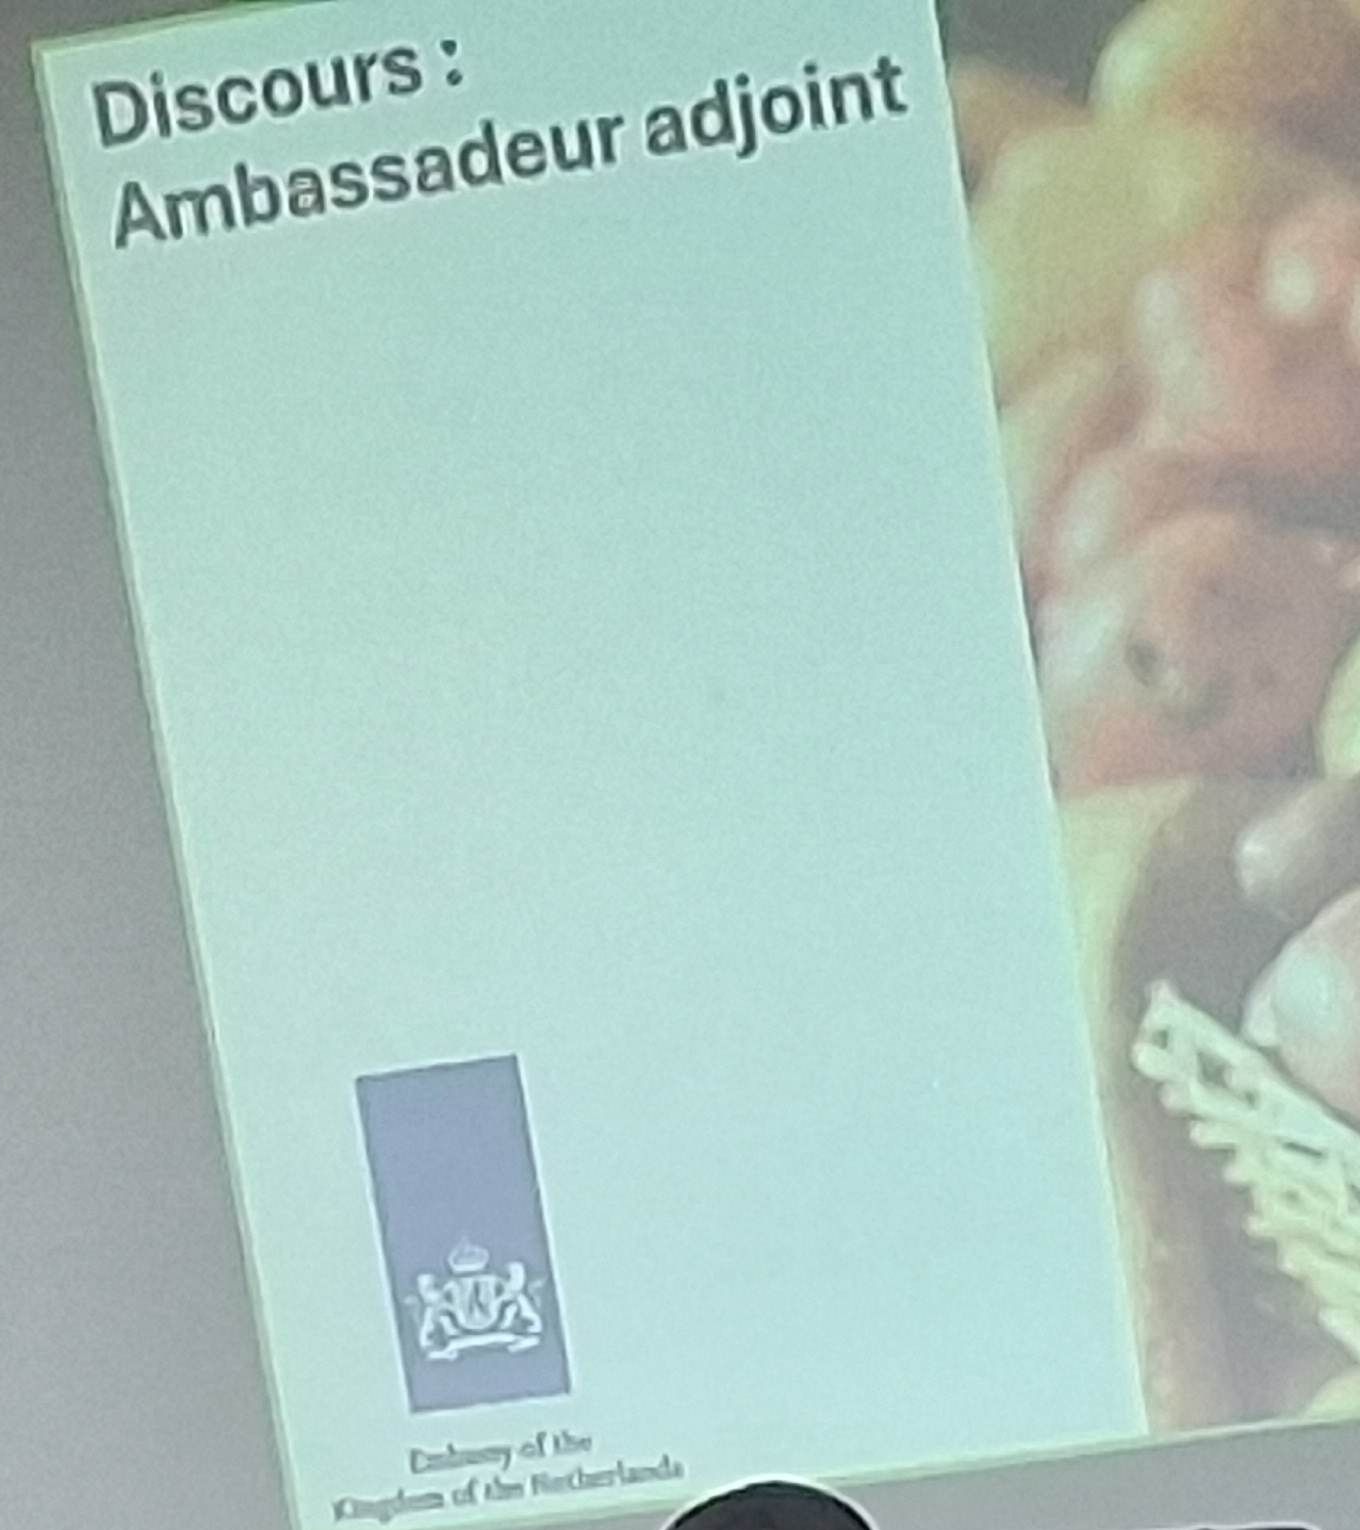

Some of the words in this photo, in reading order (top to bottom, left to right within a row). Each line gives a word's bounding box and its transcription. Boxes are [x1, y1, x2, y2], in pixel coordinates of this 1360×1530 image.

[92, 43, 423, 147] Discours
[439, 39, 463, 86] :
[113, 111, 626, 248] Ambassadeur
[644, 55, 908, 159] adjoint
[520, 1431, 546, 1458] of
[452, 1477, 479, 1506] of
